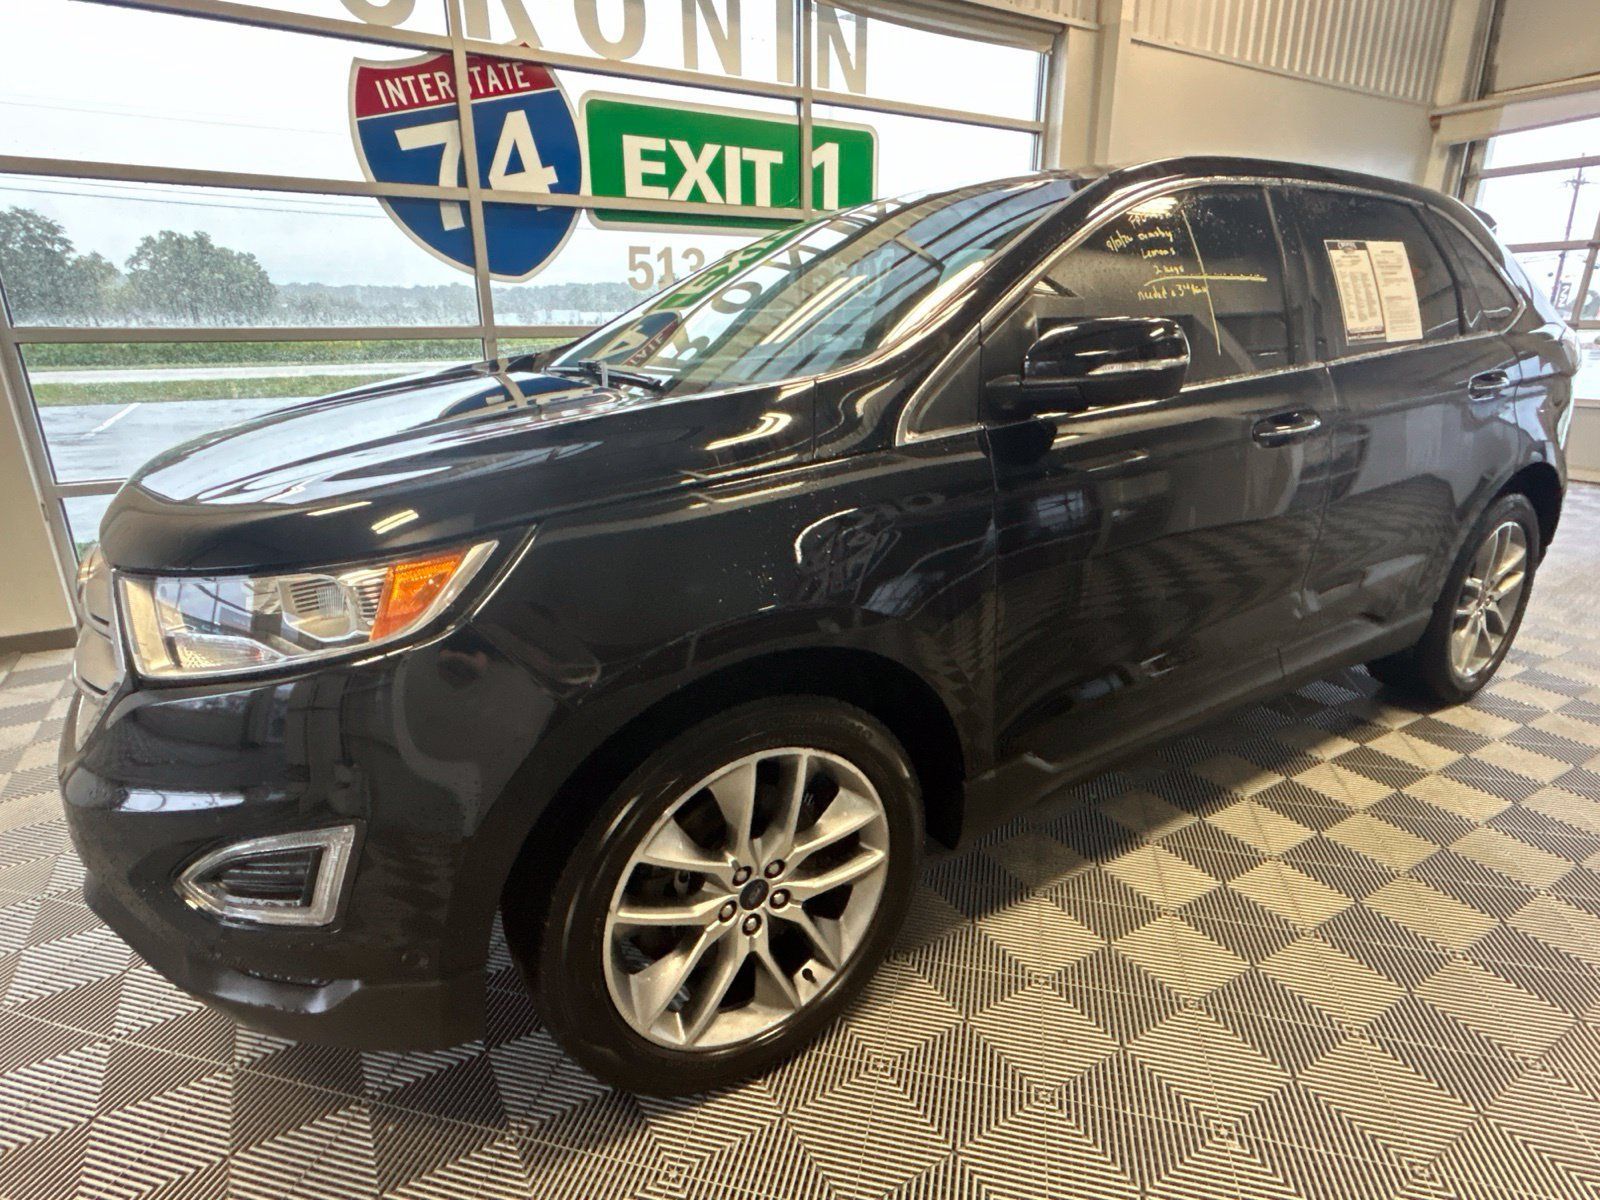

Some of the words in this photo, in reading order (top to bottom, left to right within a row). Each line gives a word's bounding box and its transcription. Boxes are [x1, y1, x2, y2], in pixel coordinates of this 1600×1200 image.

[375, 62, 531, 110] INTERTATE
[395, 109, 559, 232] 74
[622, 133, 784, 208] EXIT
[811, 142, 840, 210] 1
